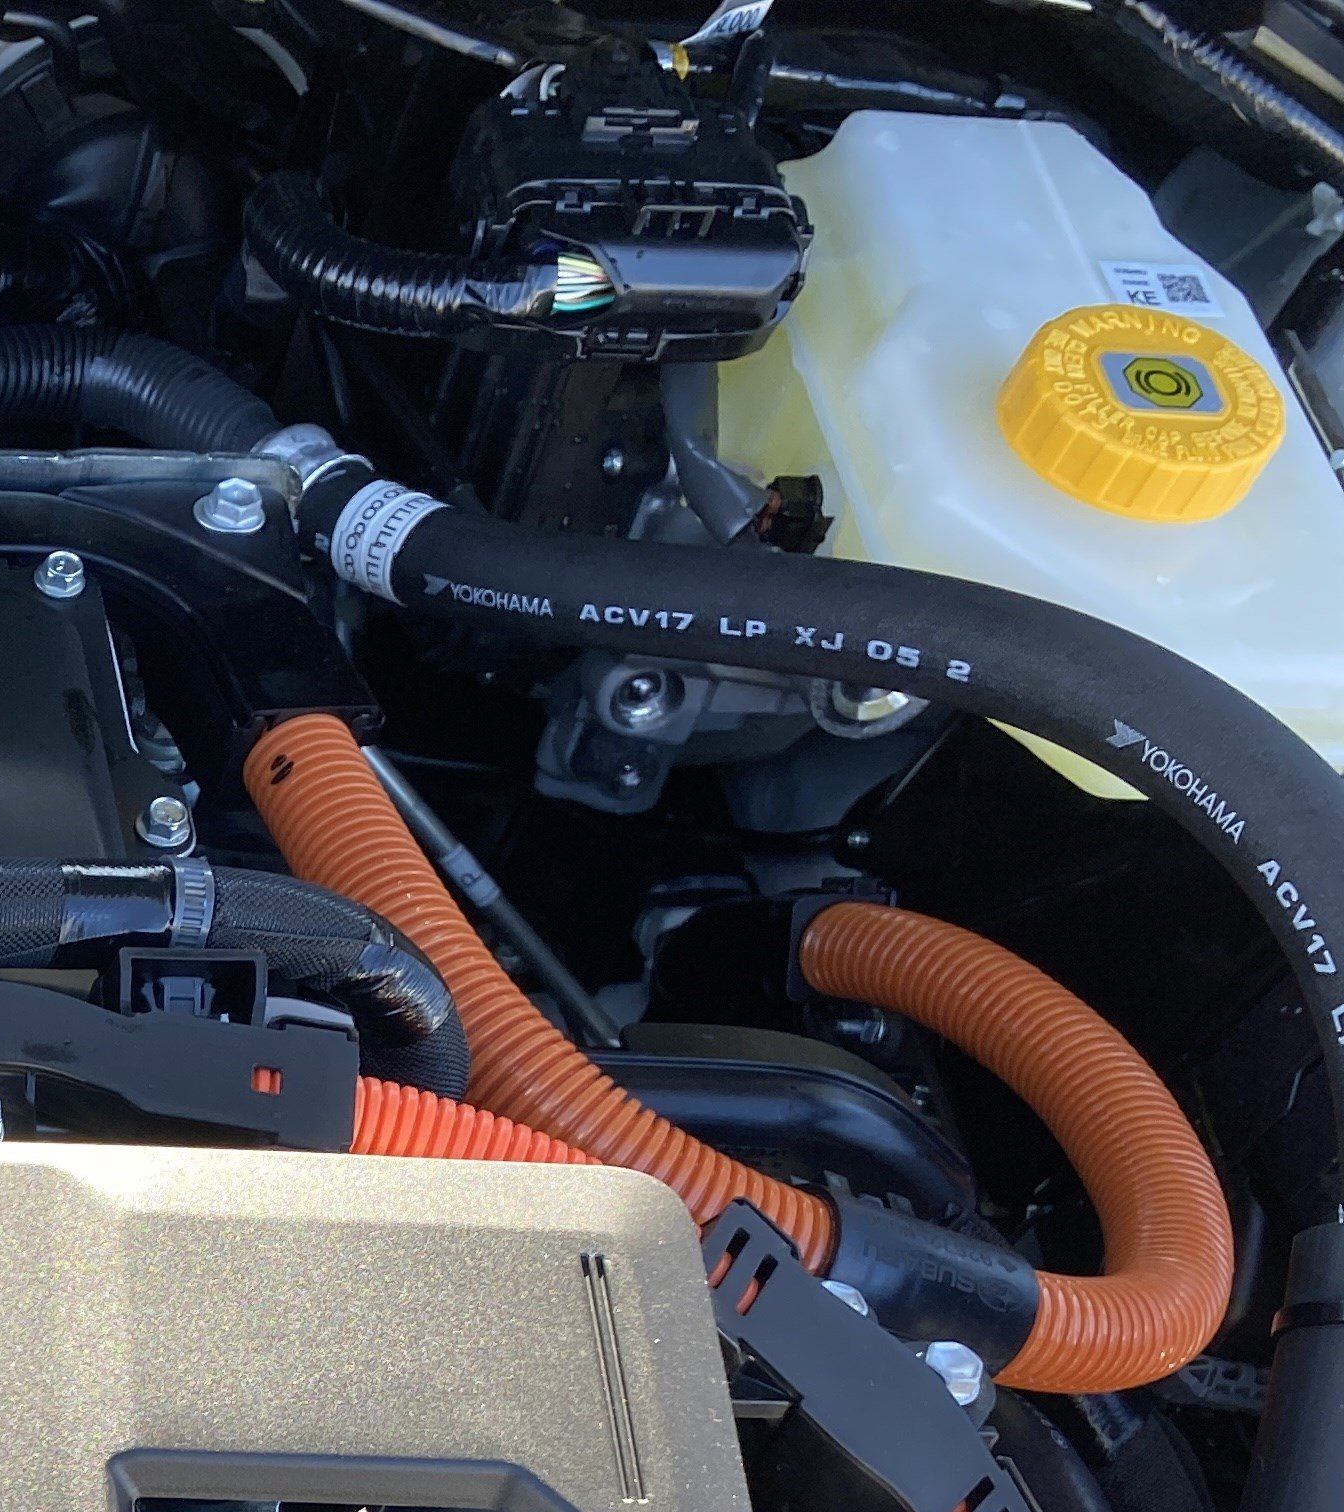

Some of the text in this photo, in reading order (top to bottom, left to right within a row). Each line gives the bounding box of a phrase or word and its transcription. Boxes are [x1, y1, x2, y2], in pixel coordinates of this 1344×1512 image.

[1127, 290, 1161, 305] KE
[449, 582, 554, 617] YOKOHAMA
[579, 603, 696, 631] ACV17
[718, 616, 767, 638] LP
[794, 625, 845, 652] XJ
[945, 659, 972, 684] 2
[1141, 738, 1344, 1045] YOKOHAMA ACV17 L
